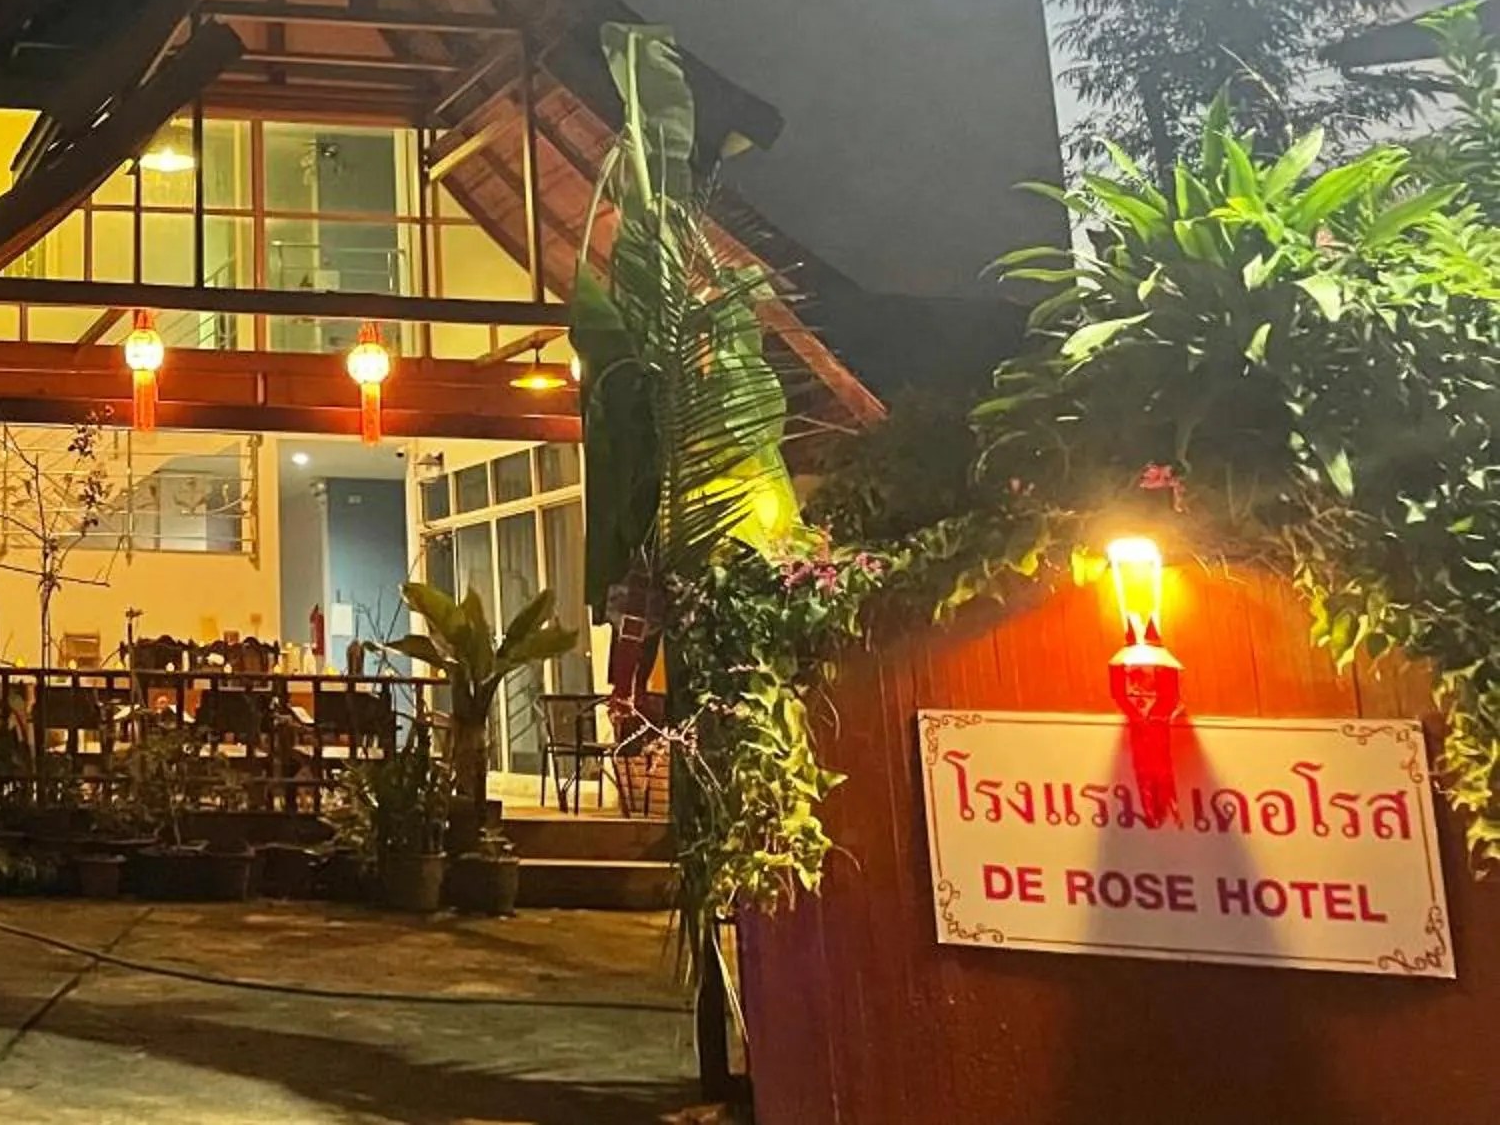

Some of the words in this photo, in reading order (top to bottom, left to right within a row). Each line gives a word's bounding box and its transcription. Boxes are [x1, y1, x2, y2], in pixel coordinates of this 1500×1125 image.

[1191, 761, 1412, 841] เดอโรส
[982, 864, 1046, 904] DE
[1064, 870, 1198, 913] ROSE
[1216, 877, 1389, 924] HOTEL
